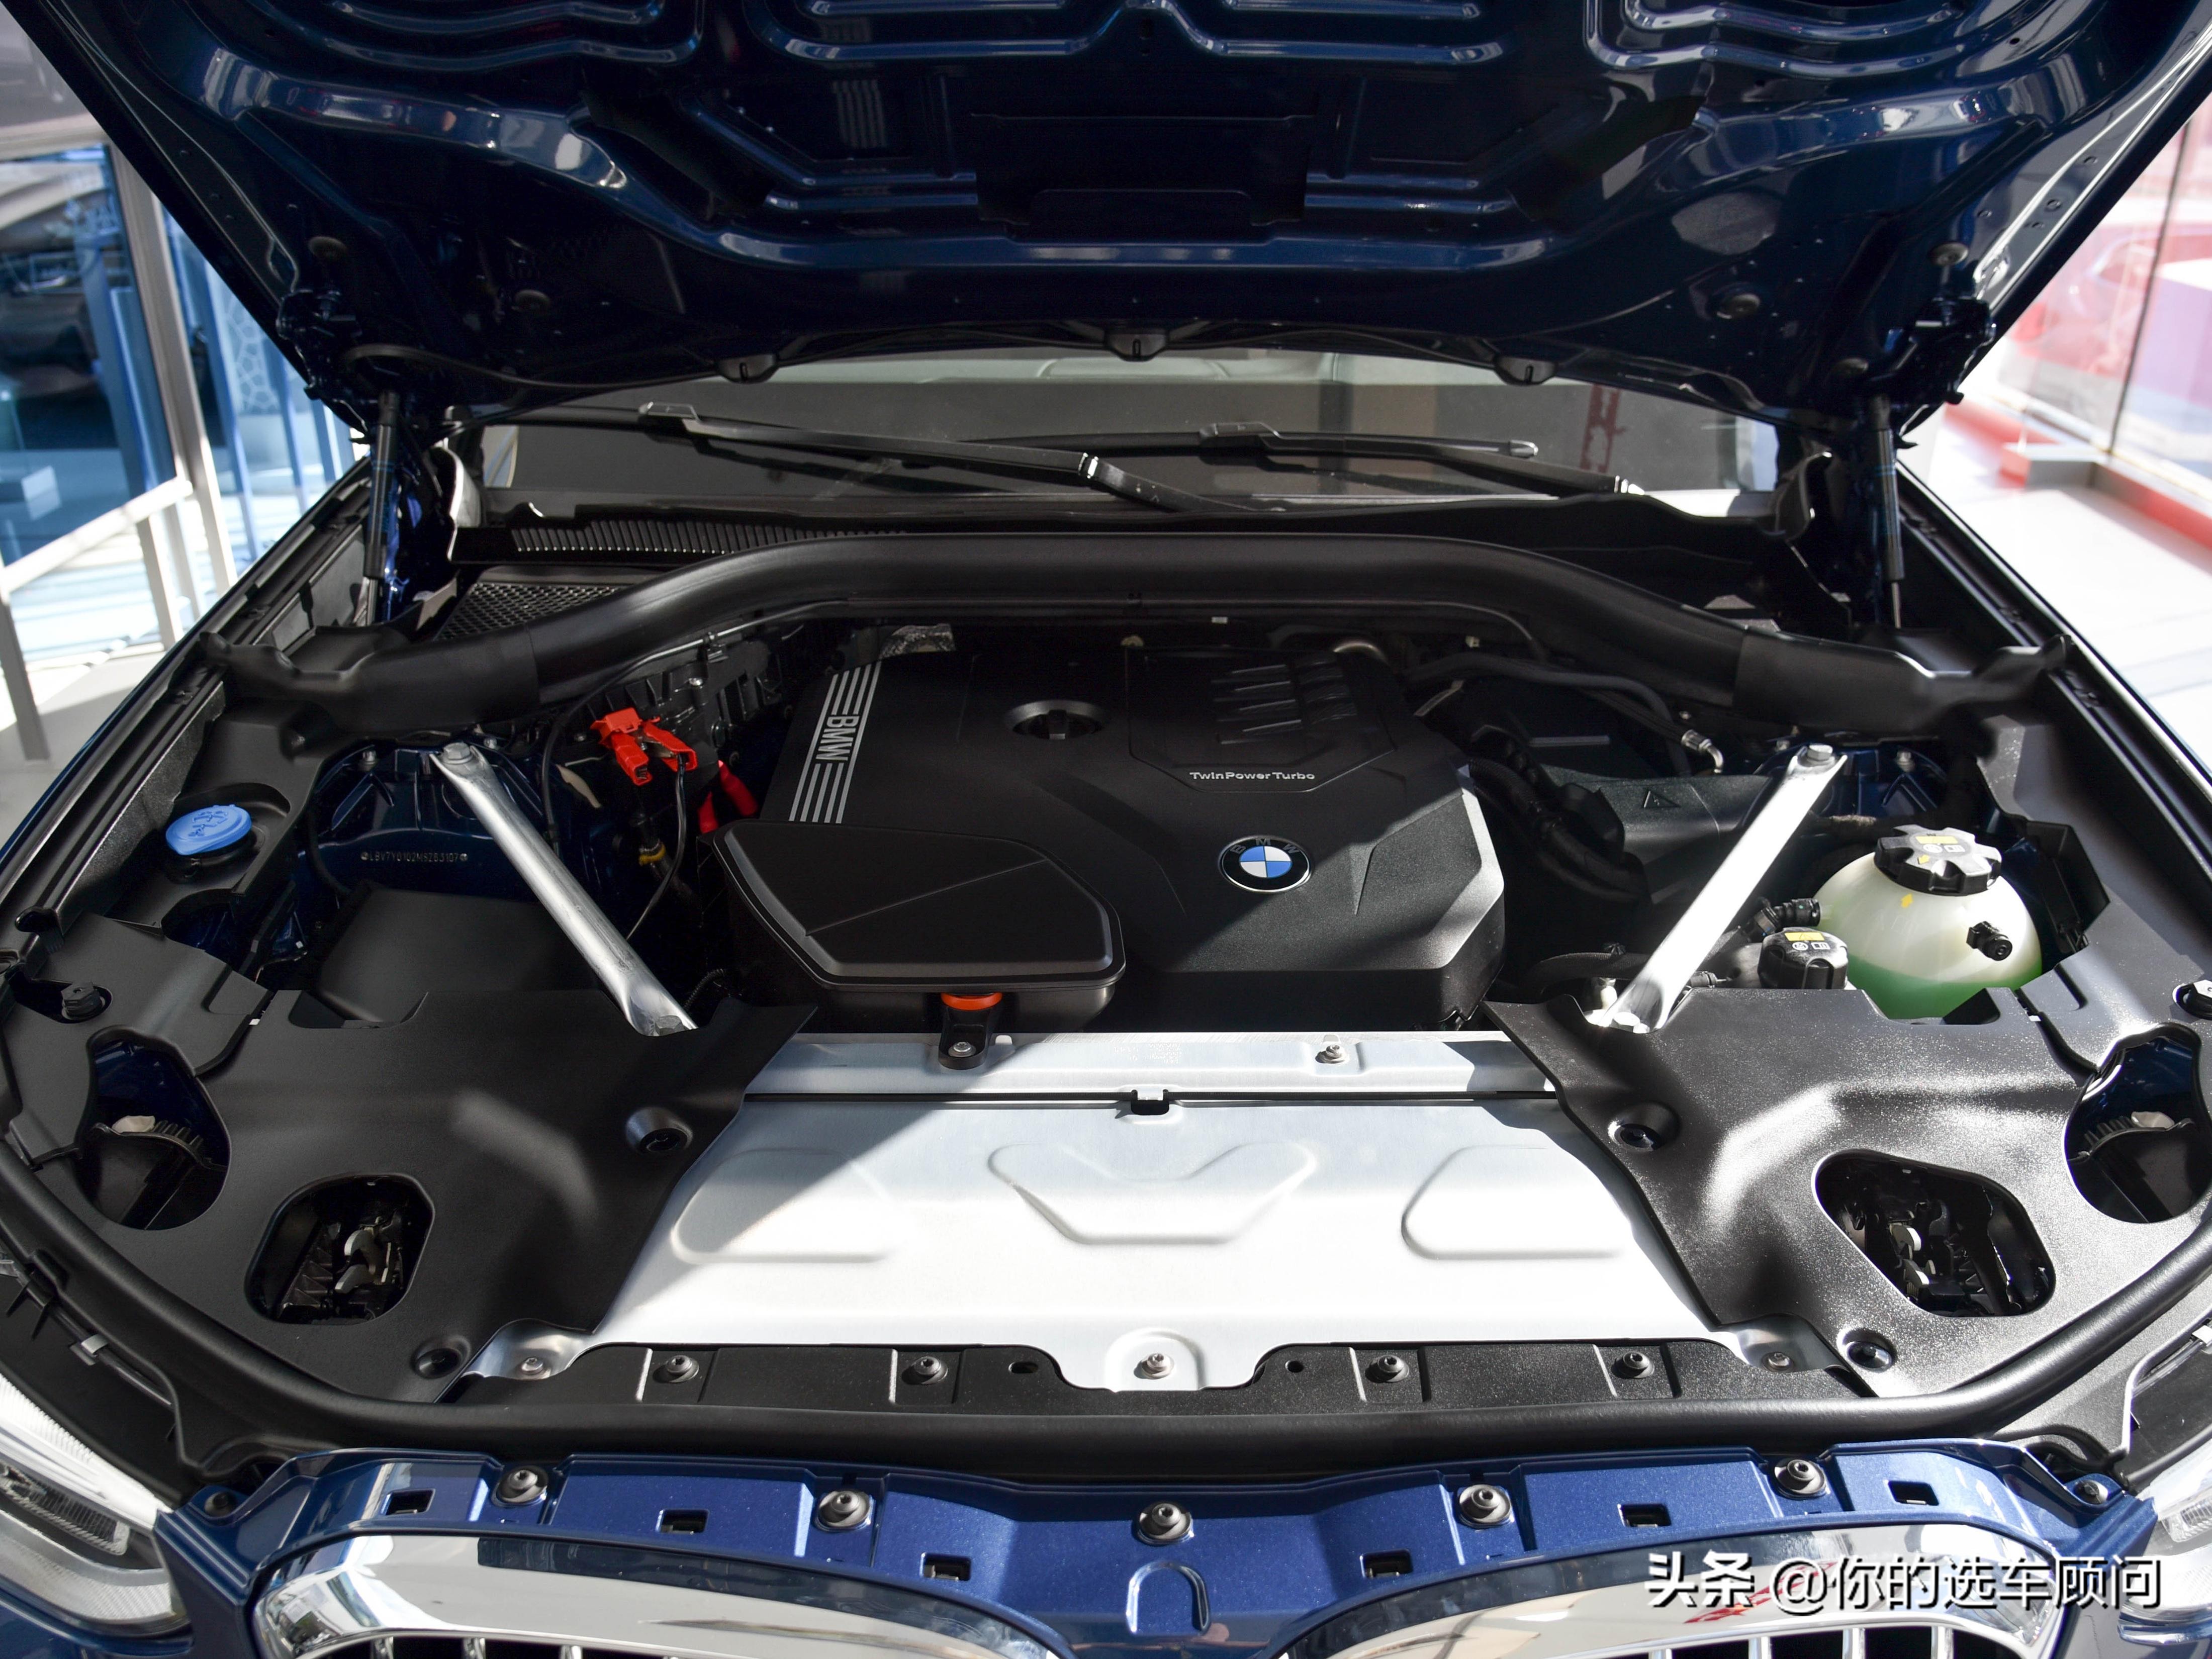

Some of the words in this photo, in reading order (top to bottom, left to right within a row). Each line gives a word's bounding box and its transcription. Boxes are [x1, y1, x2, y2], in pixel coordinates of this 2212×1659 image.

[815, 716, 860, 761] BMW
[1272, 772, 1315, 780] Turbo
[1230, 838, 1300, 854] BMW
